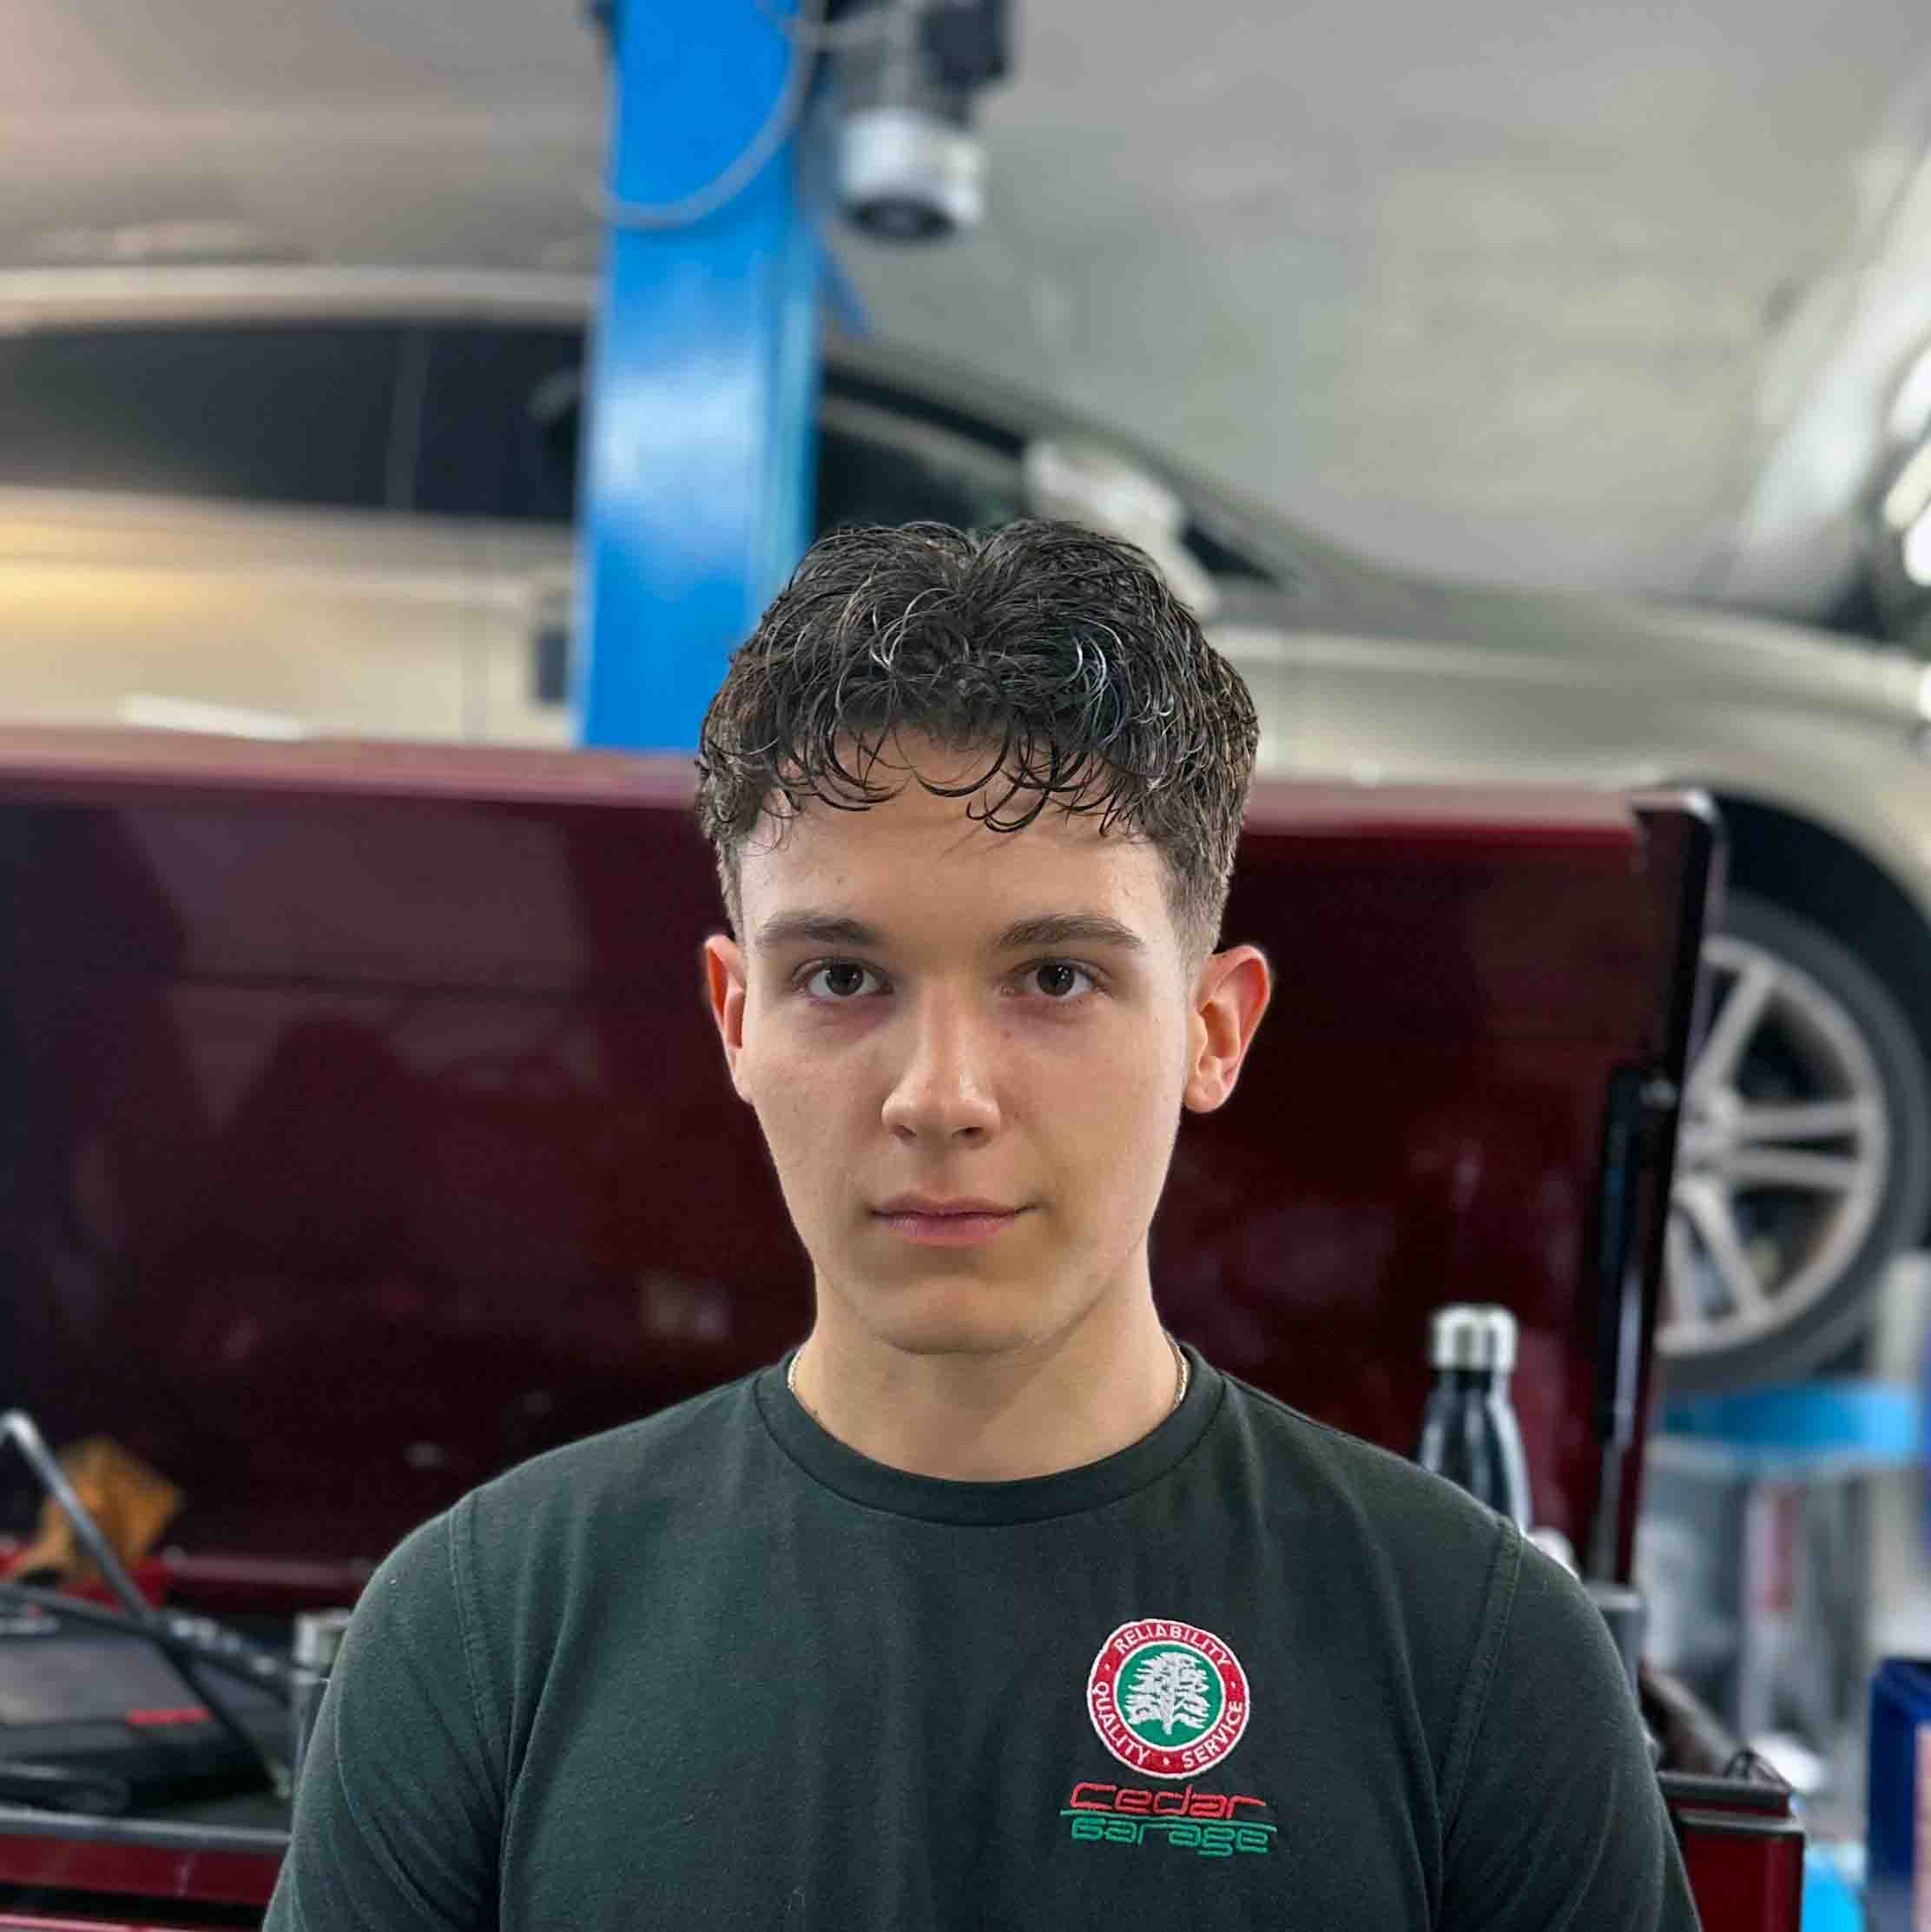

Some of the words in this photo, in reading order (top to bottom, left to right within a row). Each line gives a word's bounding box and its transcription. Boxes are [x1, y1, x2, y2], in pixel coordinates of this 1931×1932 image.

[1113, 1623, 1232, 1666] RELIABILITY
[1091, 1681, 1151, 1765] QUALITY
[1181, 1700, 1243, 1769] SERVICE
